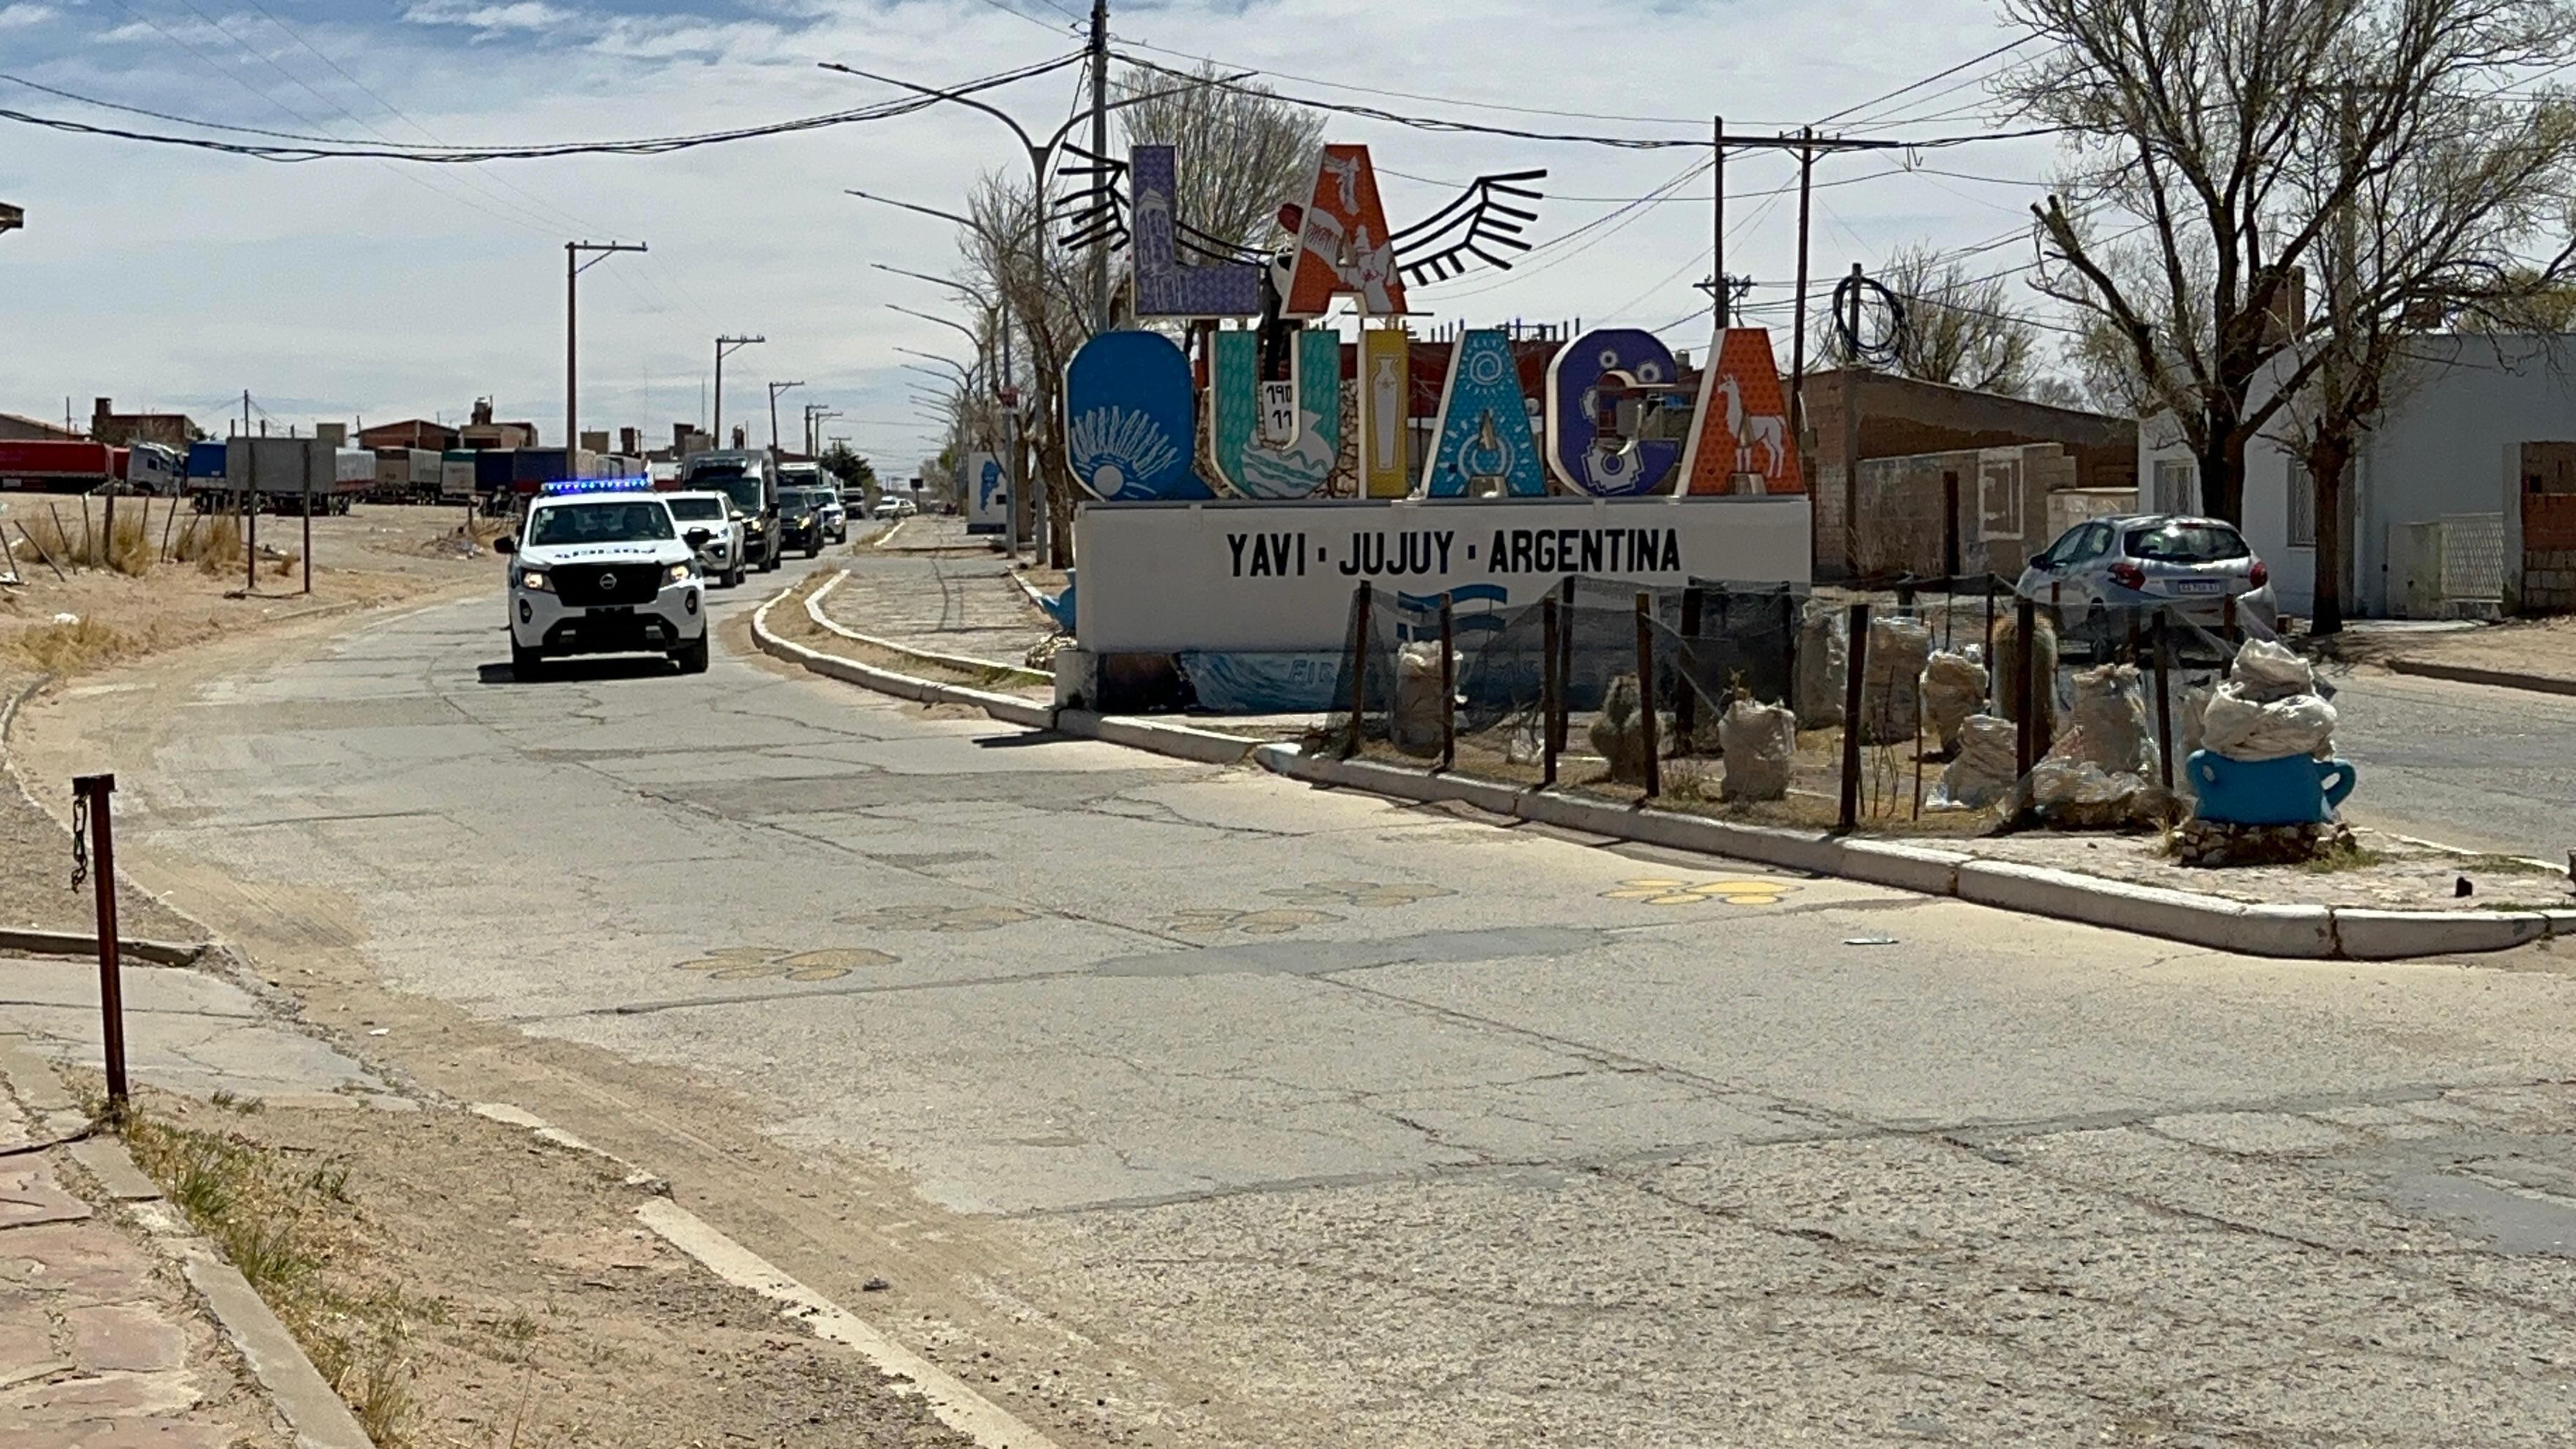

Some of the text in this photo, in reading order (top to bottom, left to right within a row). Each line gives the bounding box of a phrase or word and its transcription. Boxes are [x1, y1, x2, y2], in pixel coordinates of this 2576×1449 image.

[1131, 144, 1408, 316] LA
[1066, 328, 1805, 500] QUIACA
[1227, 528, 1681, 577] YAVI JUJUY ARGENTINA
